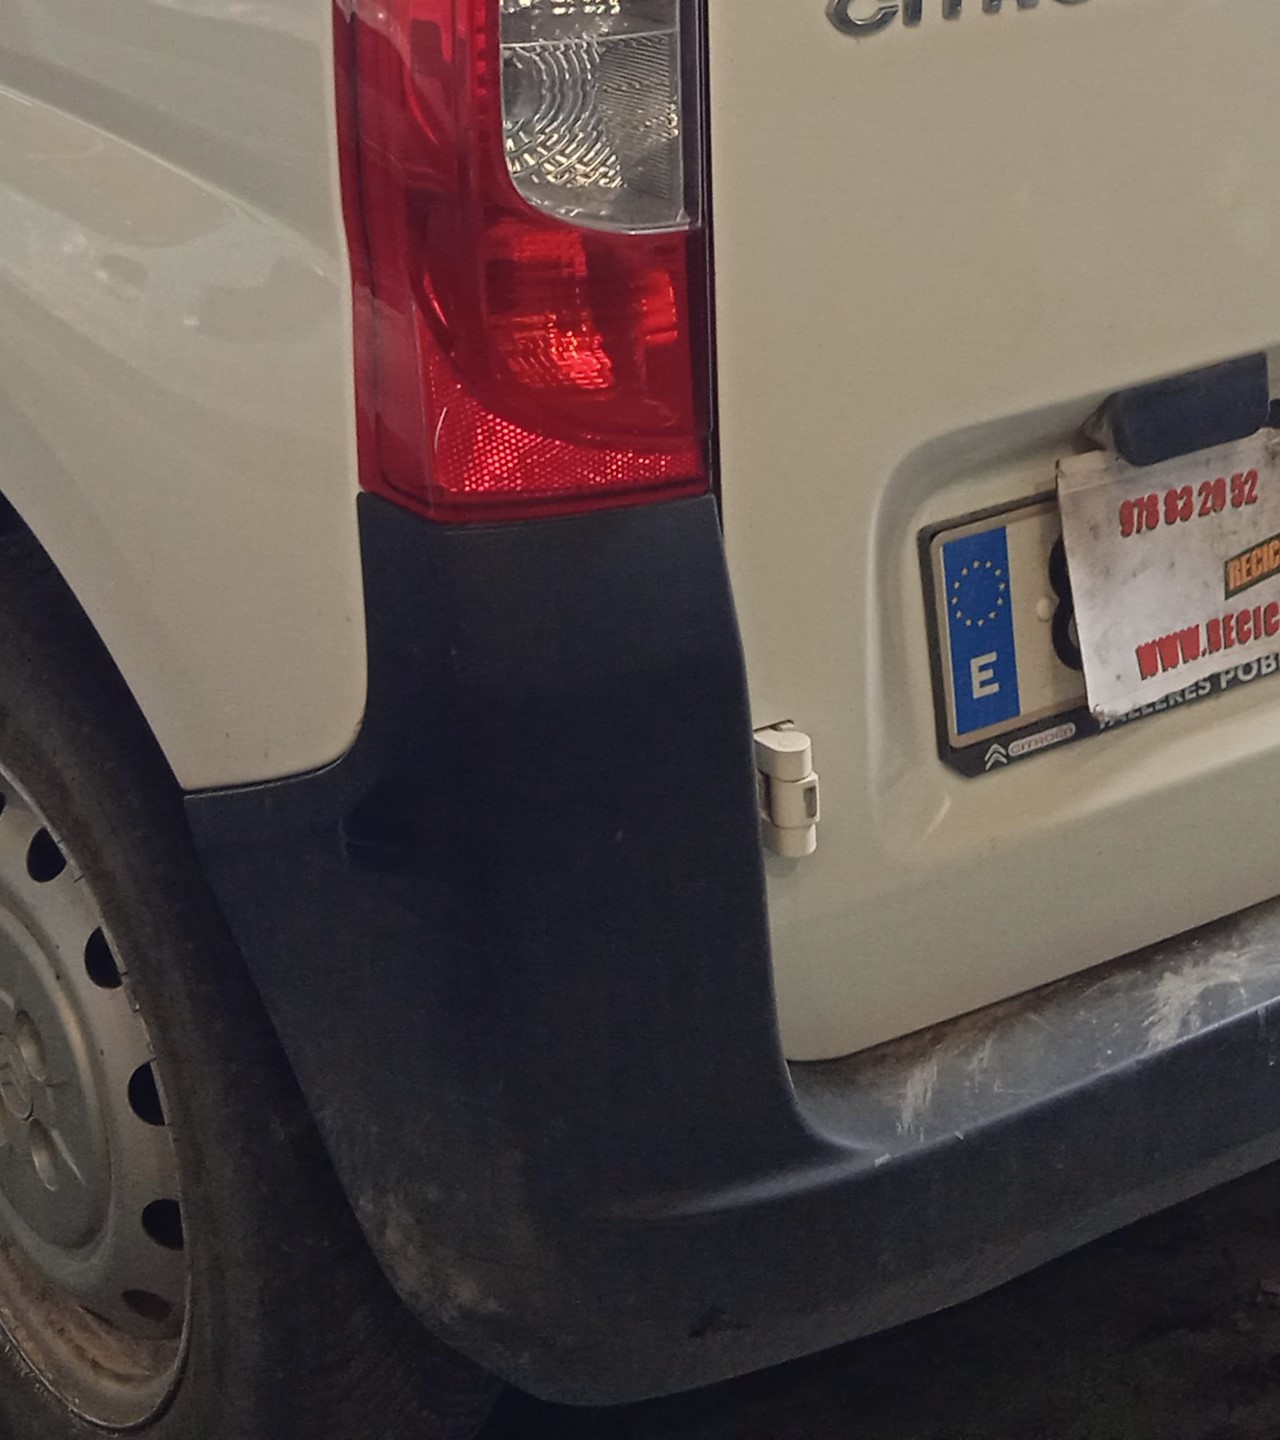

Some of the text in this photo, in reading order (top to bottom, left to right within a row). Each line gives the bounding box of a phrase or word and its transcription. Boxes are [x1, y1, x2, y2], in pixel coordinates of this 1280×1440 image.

[1120, 468, 1259, 537] 978 83 20 52
[970, 651, 1000, 699] E
